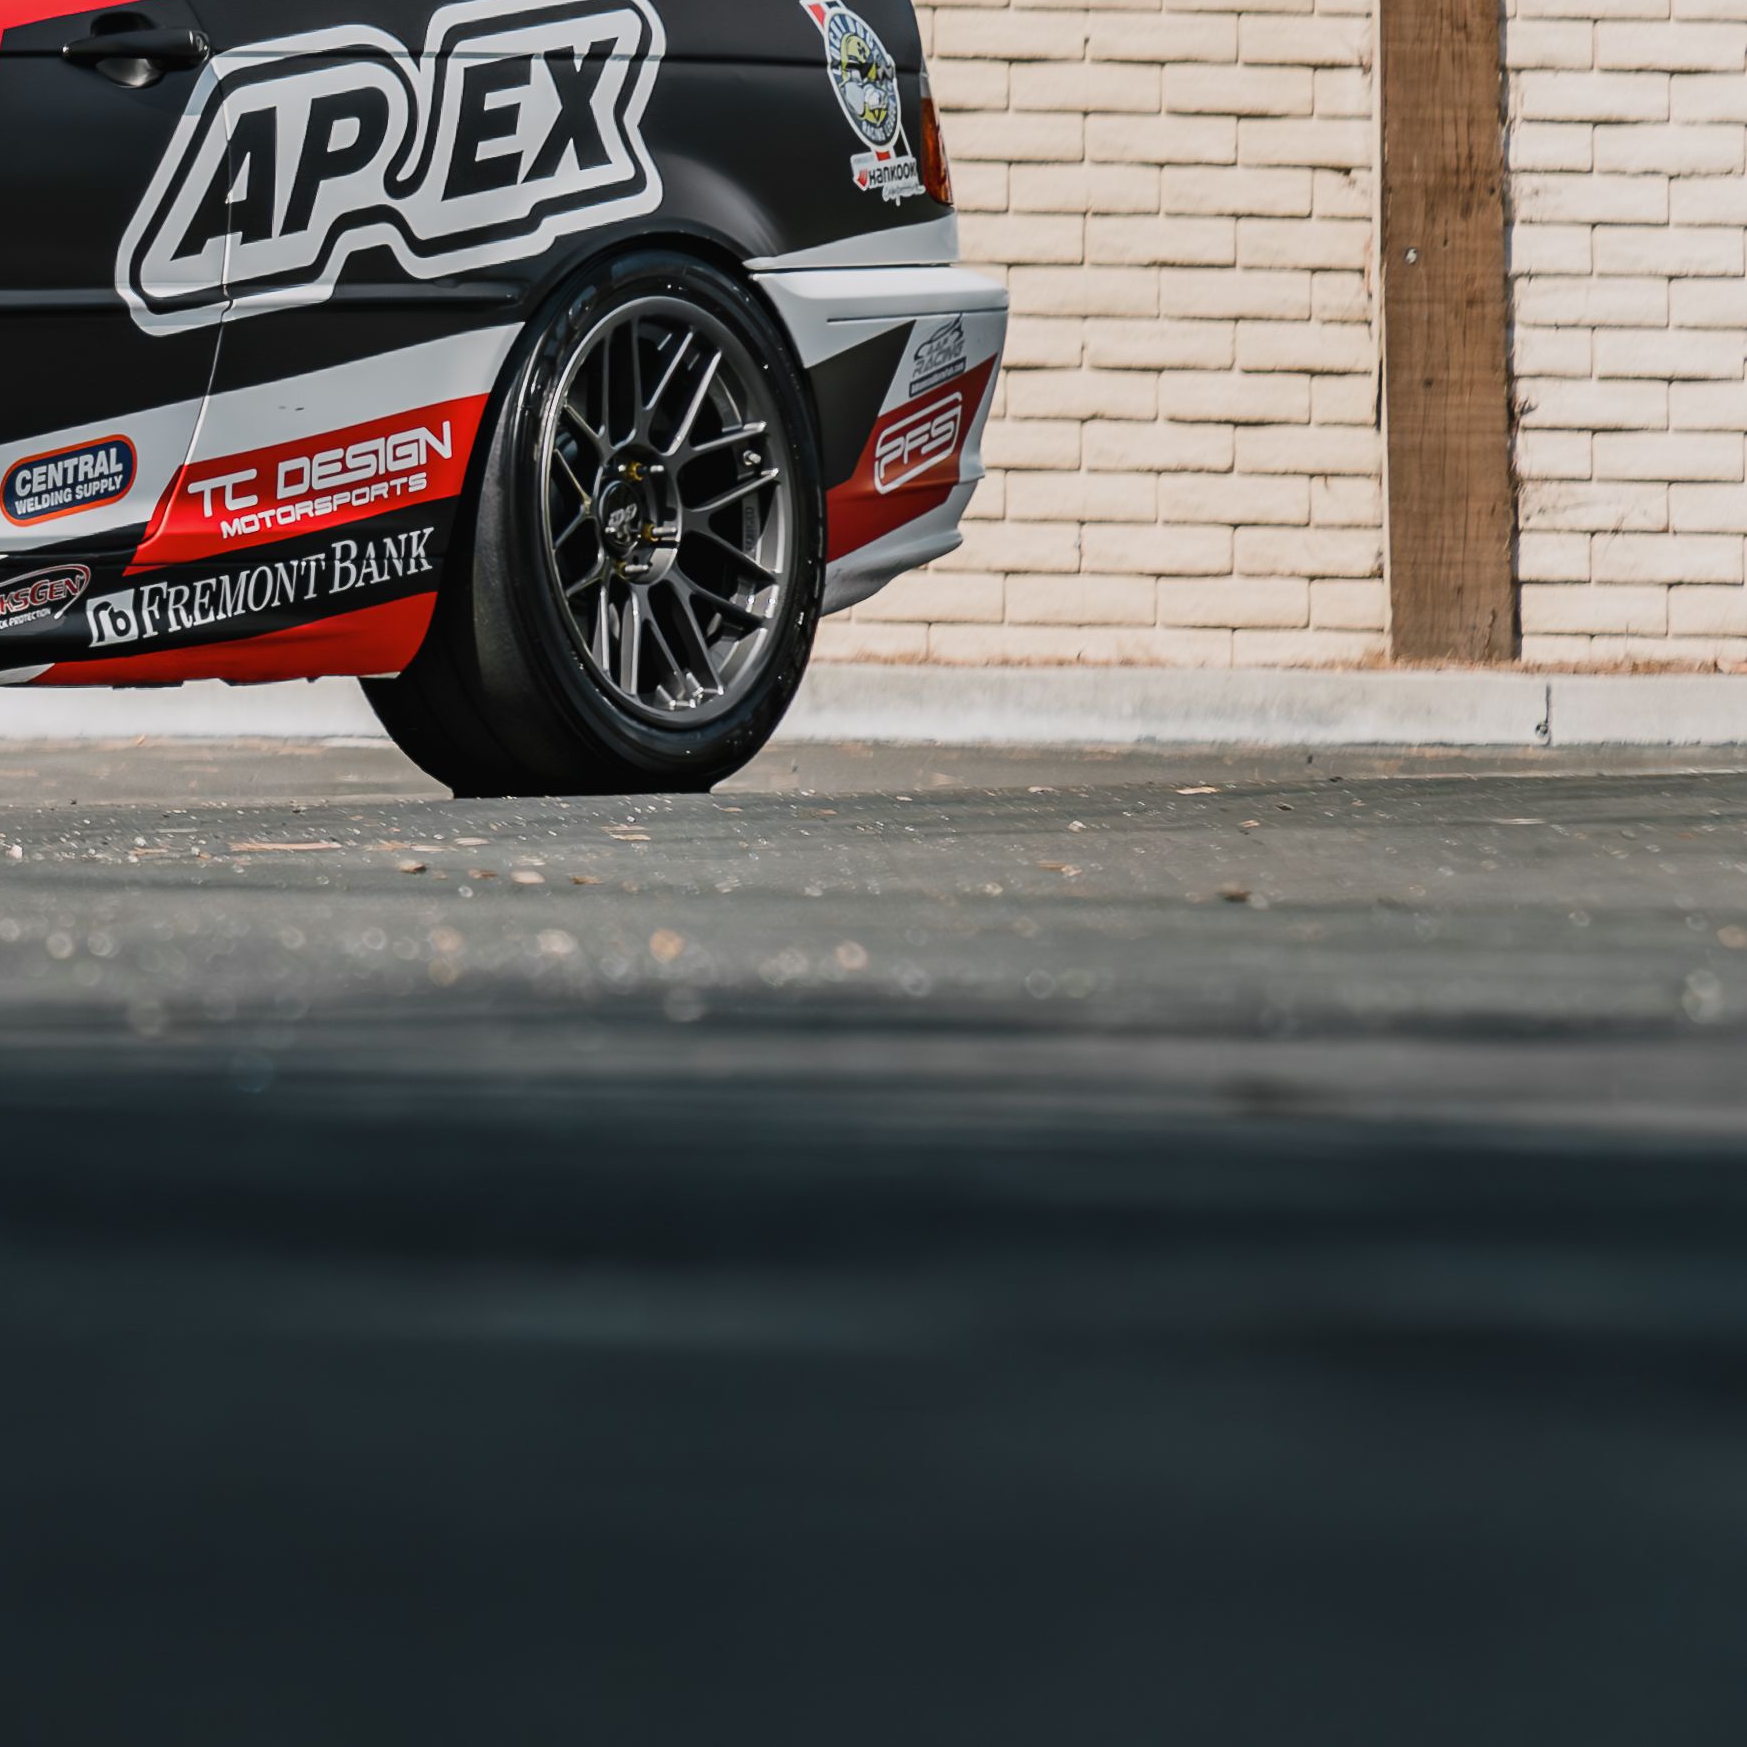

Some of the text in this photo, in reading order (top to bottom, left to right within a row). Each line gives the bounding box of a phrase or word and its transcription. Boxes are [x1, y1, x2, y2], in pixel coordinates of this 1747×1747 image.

[161, 30, 631, 270] APEX
[14, 474, 124, 516] WELDING SUPPLY
[15, 447, 124, 497] CENTRAL
[188, 420, 453, 518] TC DESIGN
[220, 472, 428, 539] MOTORSPORTS
[139, 526, 436, 640] FREMONT BANK
[9, 607, 52, 627] PROTECTION
